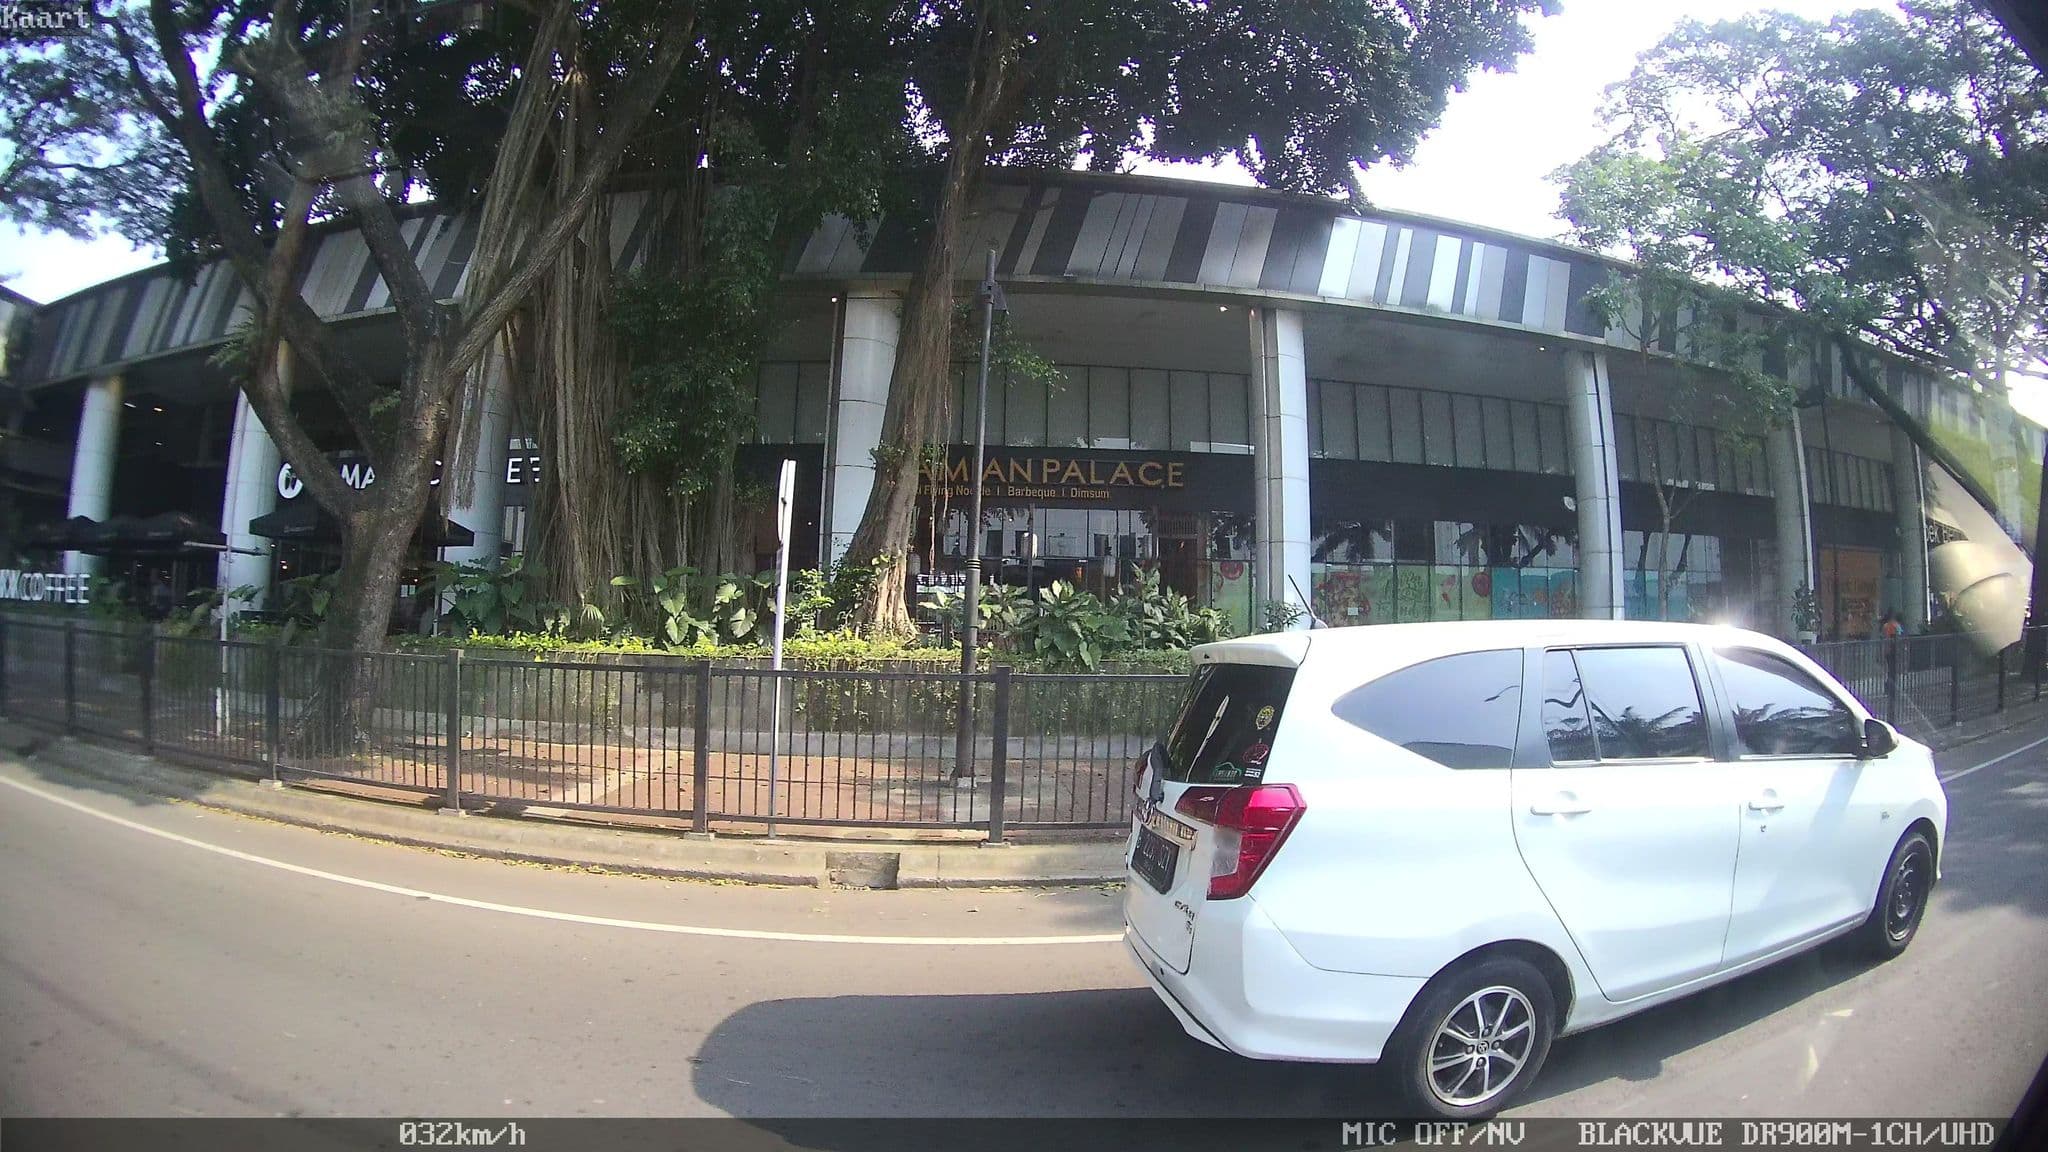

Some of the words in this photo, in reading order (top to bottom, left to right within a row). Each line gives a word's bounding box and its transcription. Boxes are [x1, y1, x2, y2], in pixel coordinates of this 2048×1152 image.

[1042, 458, 1184, 487] PALACE
[1007, 485, 1056, 500] Barbeque
[1070, 487, 1110, 499] Dimsum
